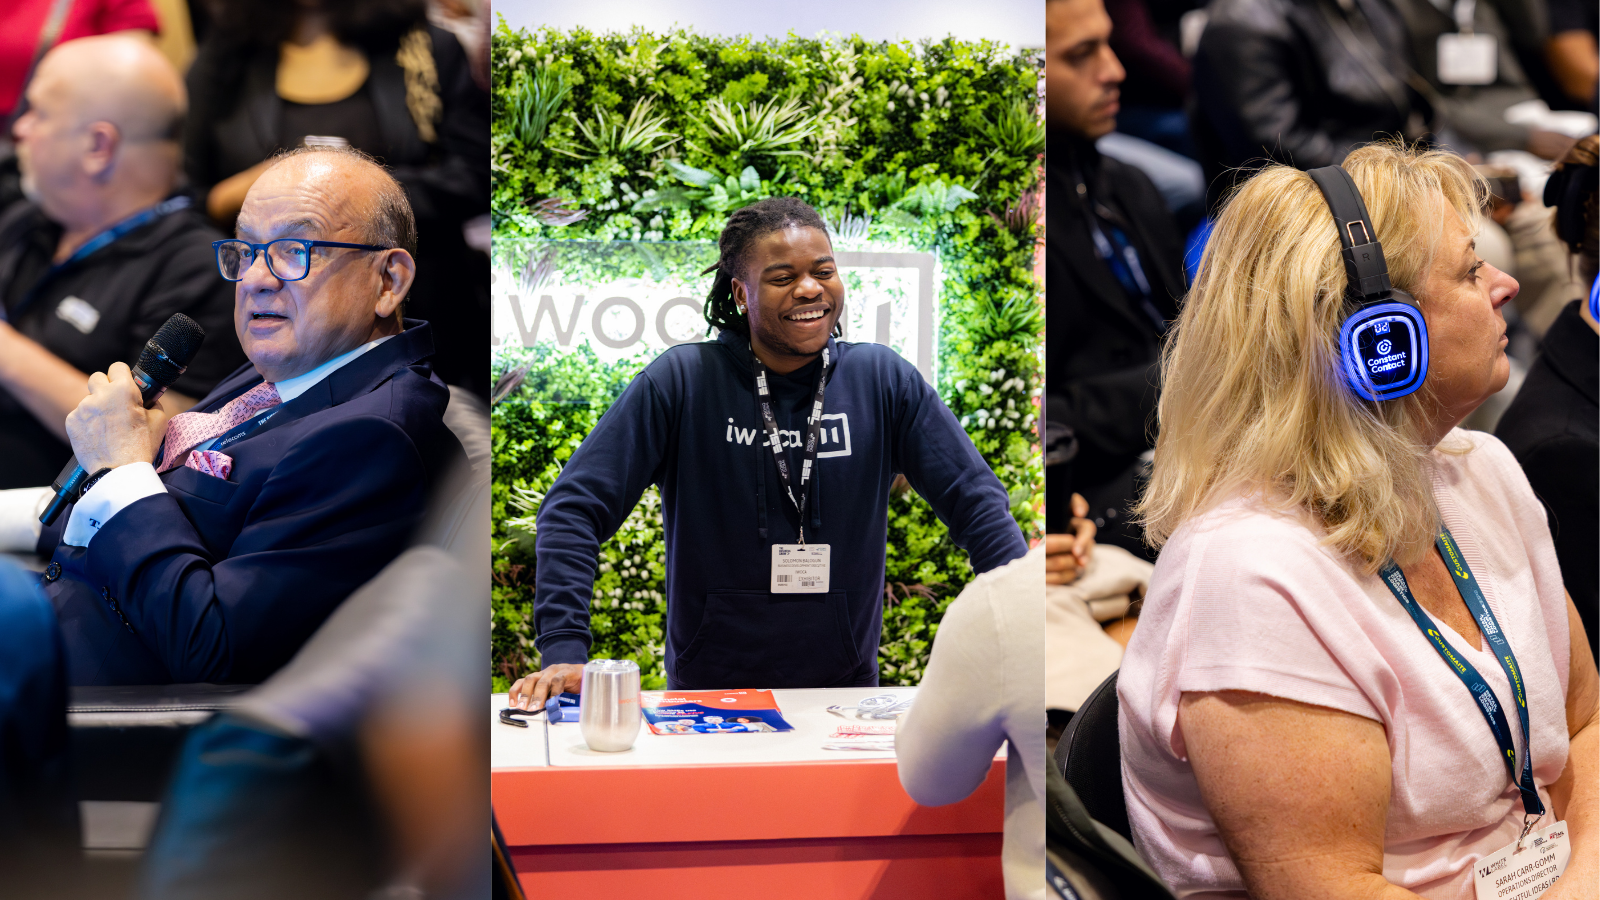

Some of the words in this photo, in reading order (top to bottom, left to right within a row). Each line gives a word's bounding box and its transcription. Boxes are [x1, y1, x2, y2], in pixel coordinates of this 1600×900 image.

[491, 273, 717, 349] iwoc
[1367, 351, 1406, 367] Constant
[1371, 360, 1405, 373] Contact
[1495, 871, 1517, 888] SARAH
[1517, 852, 1556, 877] CARR-GOMM
[1498, 876, 1532, 898] OPERATIONS
[1531, 864, 1557, 881] DIRECTOR
[1531, 880, 1549, 895] IDEAS
